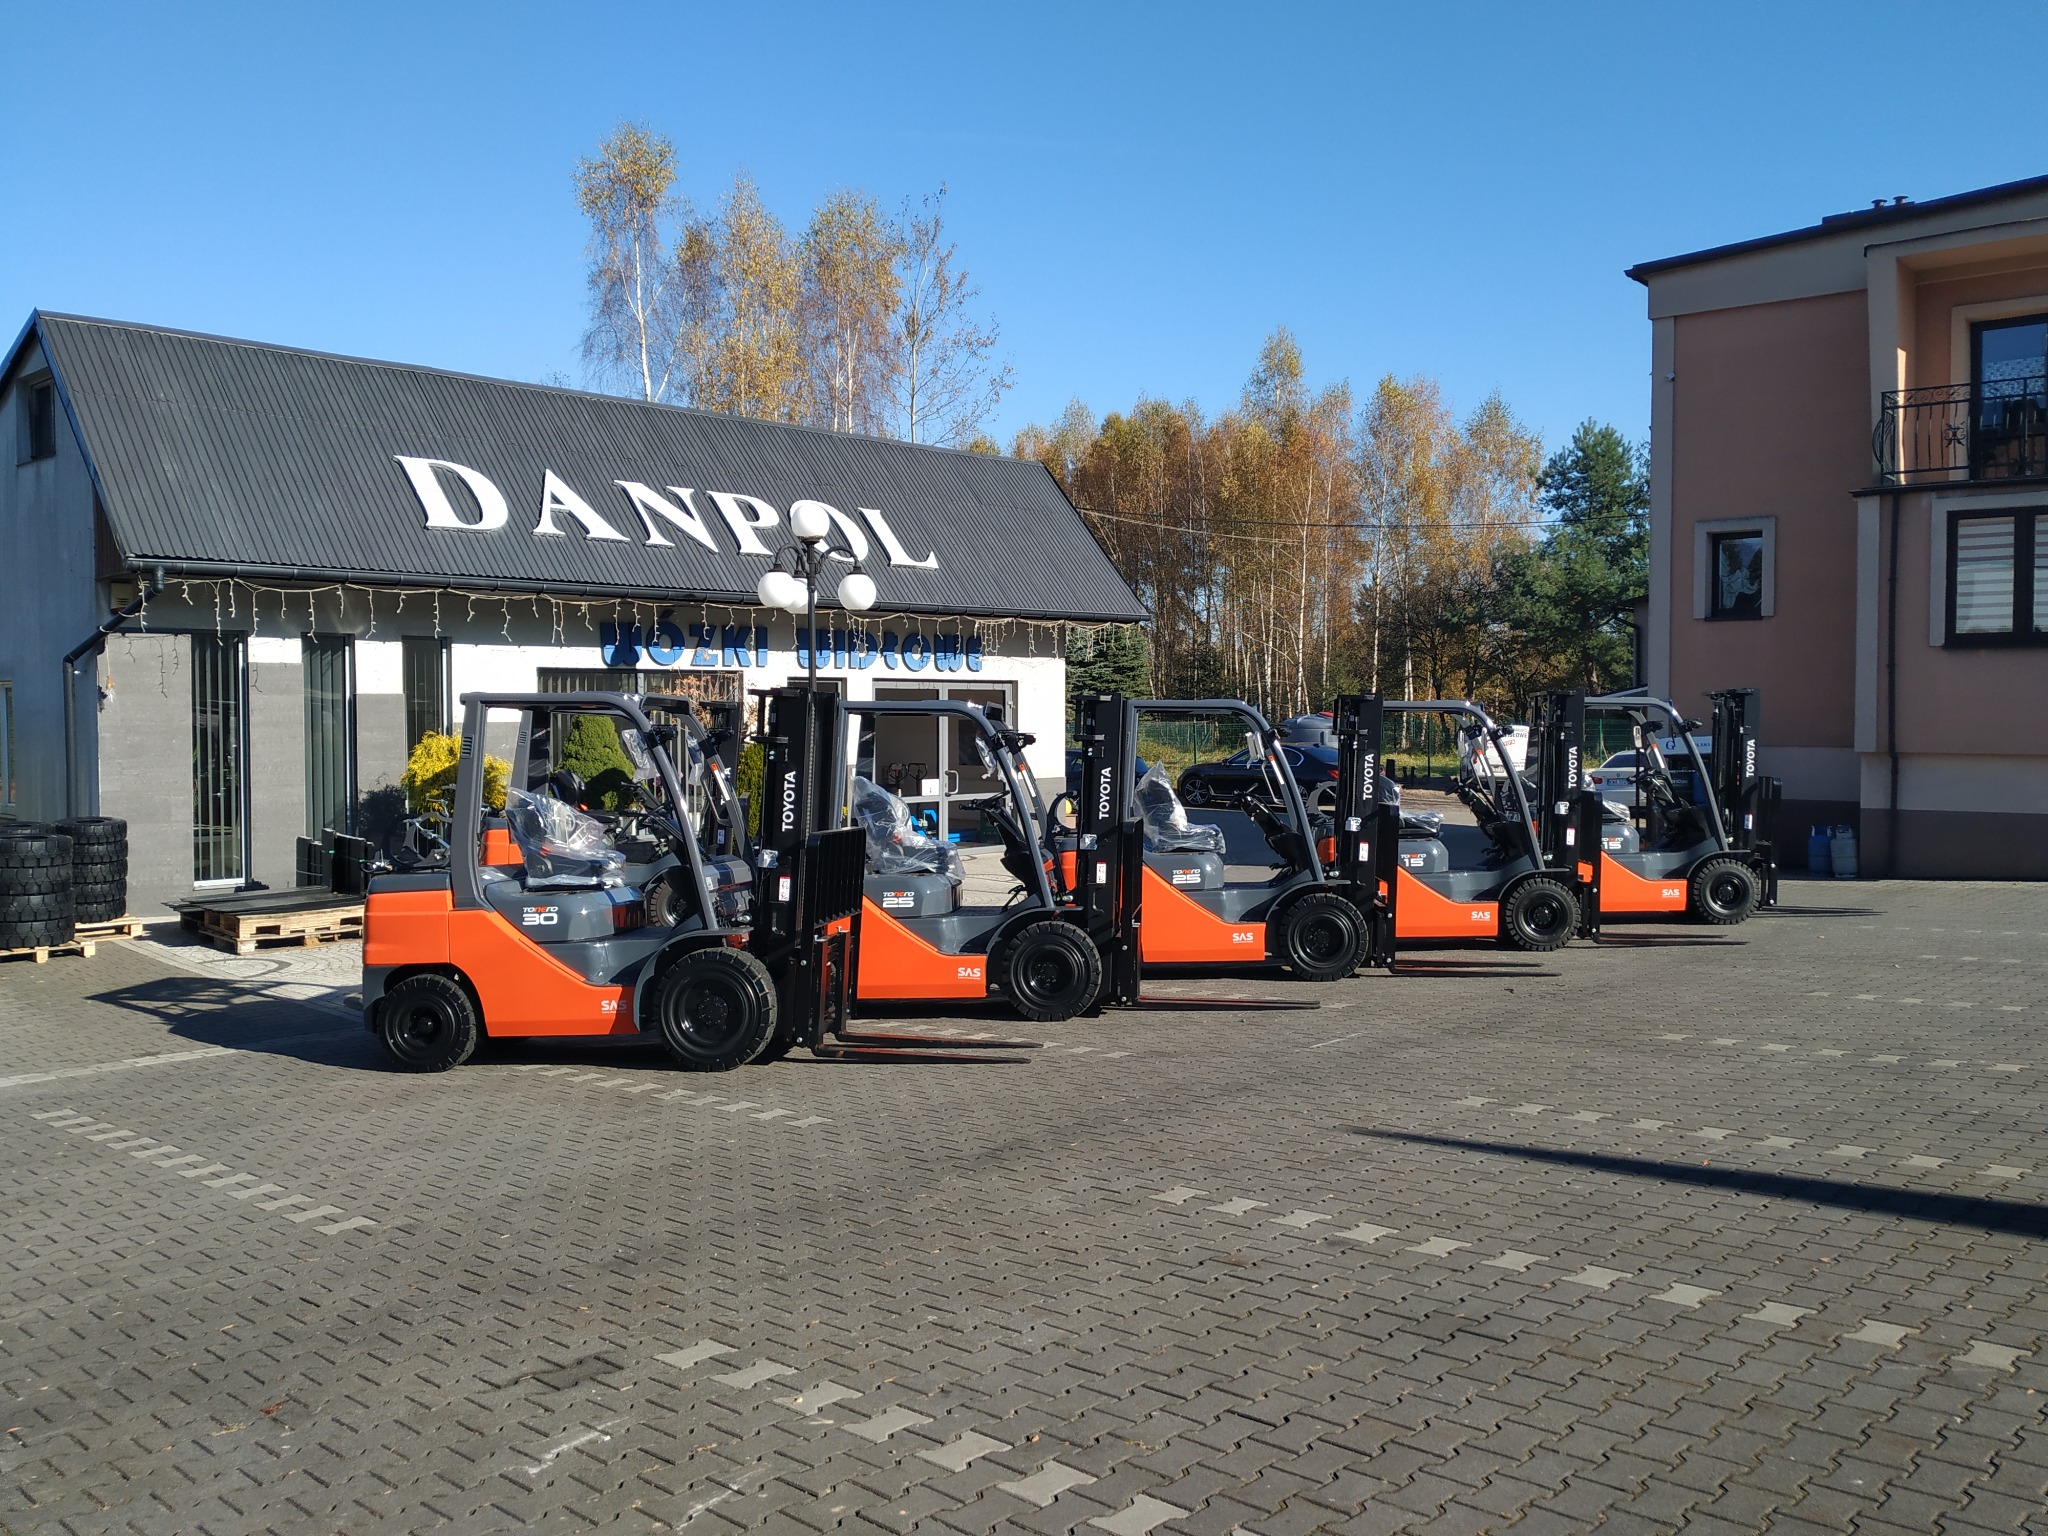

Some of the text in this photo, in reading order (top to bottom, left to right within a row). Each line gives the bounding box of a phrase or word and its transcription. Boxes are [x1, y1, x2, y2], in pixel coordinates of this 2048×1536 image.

[394, 455, 939, 570] DANPOL
[600, 610, 982, 672] WÓZKI WIDŁOWE
[1746, 739, 1756, 777] TOYOTA
[1568, 746, 1578, 789] TOYOTA
[1363, 753, 1374, 800] TOYOTA
[1098, 767, 1112, 820] TOYOTA
[781, 771, 796, 832] TOYOTA
[1602, 841, 1622, 850] 15
[1403, 858, 1425, 867] 15
[1172, 874, 1202, 884] 25
[1661, 888, 1680, 896] SAS
[882, 897, 915, 908] 25
[522, 912, 558, 926] 30
[1471, 911, 1491, 919] SAS
[1232, 932, 1254, 941] SAS
[957, 966, 981, 977] SAS
[600, 1000, 627, 1011] SAS
